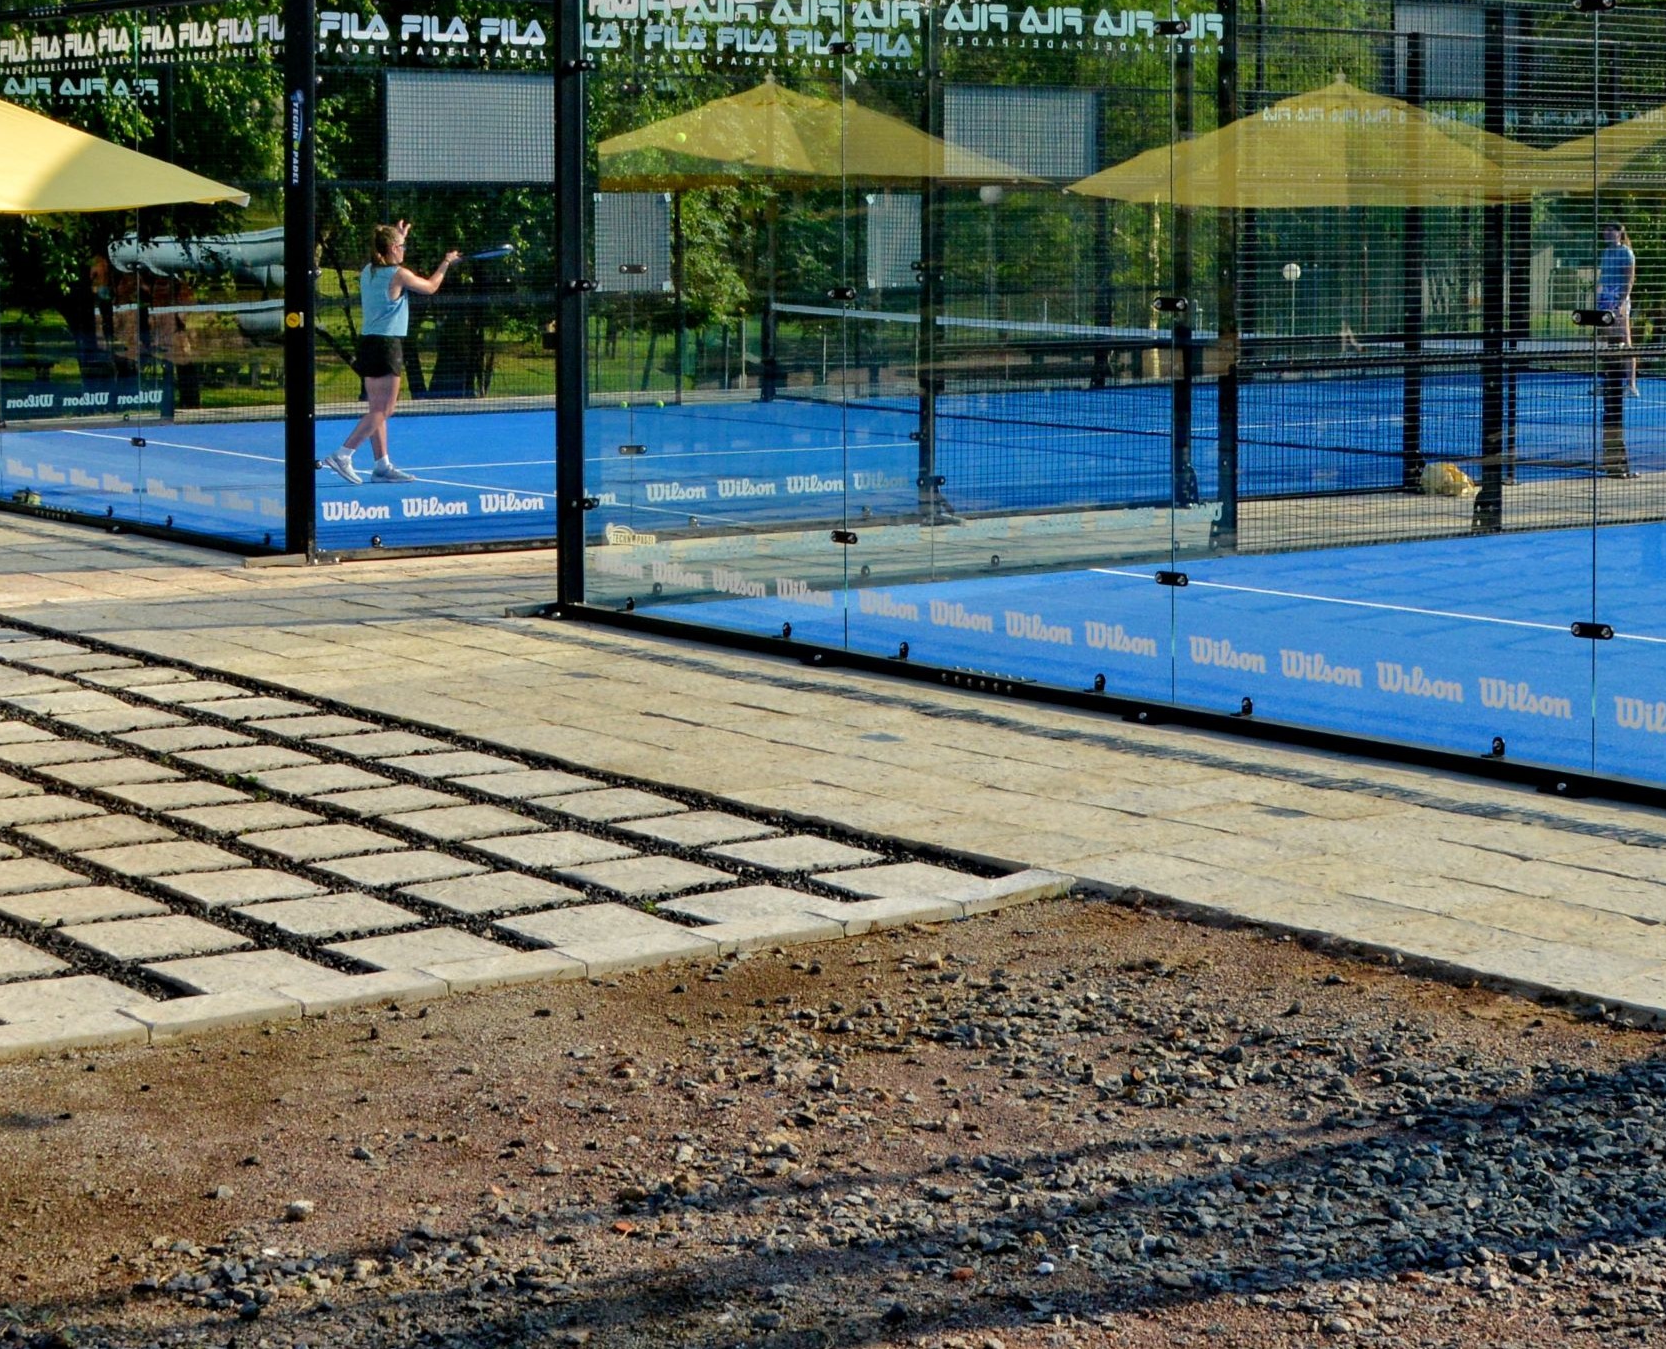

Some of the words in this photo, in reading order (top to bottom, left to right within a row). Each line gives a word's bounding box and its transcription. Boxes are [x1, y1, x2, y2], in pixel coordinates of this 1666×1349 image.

[0, 37, 28, 63] FILA
[31, 35, 61, 60] FILA
[64, 32, 95, 57] FILA
[98, 27, 130, 53] FILA
[141, 24, 175, 51] FILA
[178, 21, 213, 48] FILA
[217, 17, 254, 44] FILA
[258, 14, 285, 42] FIL
[319, 11, 389, 40] FILA
[401, 14, 469, 42] FILA
[480, 17, 546, 45] FILA
[644, 24, 706, 50] FILA
[717, 27, 777, 53] FILA
[854, 32, 913, 57] FILA
[319, 43, 389, 55] PADEL
[401, 46, 469, 56] PADEL
[480, 49, 546, 60] PADEL
[645, 54, 707, 63] PADEL
[717, 55, 777, 66] PADEL
[855, 61, 913, 70] PADEL
[64, 61, 95, 70] PADEL
[322, 500, 390, 521] Wilson
[401, 496, 468, 517] Wilson
[479, 493, 544, 513] Wilson
[645, 482, 707, 501] Wilson
[717, 478, 776, 498] Wilson
[786, 475, 844, 493] Wilson
[652, 562, 703, 589] Wilson
[712, 568, 766, 598] Wilson
[775, 577, 832, 606] Wilson
[858, 589, 919, 622] Wilson
[930, 599, 993, 633] Wilson
[1005, 610, 1073, 645] Wilson
[1084, 621, 1157, 657] Wilson
[1189, 636, 1266, 674] Wilson
[1280, 649, 1363, 688] Wilson
[1376, 661, 1464, 703] Wilson
[1479, 676, 1572, 719] Wilson
